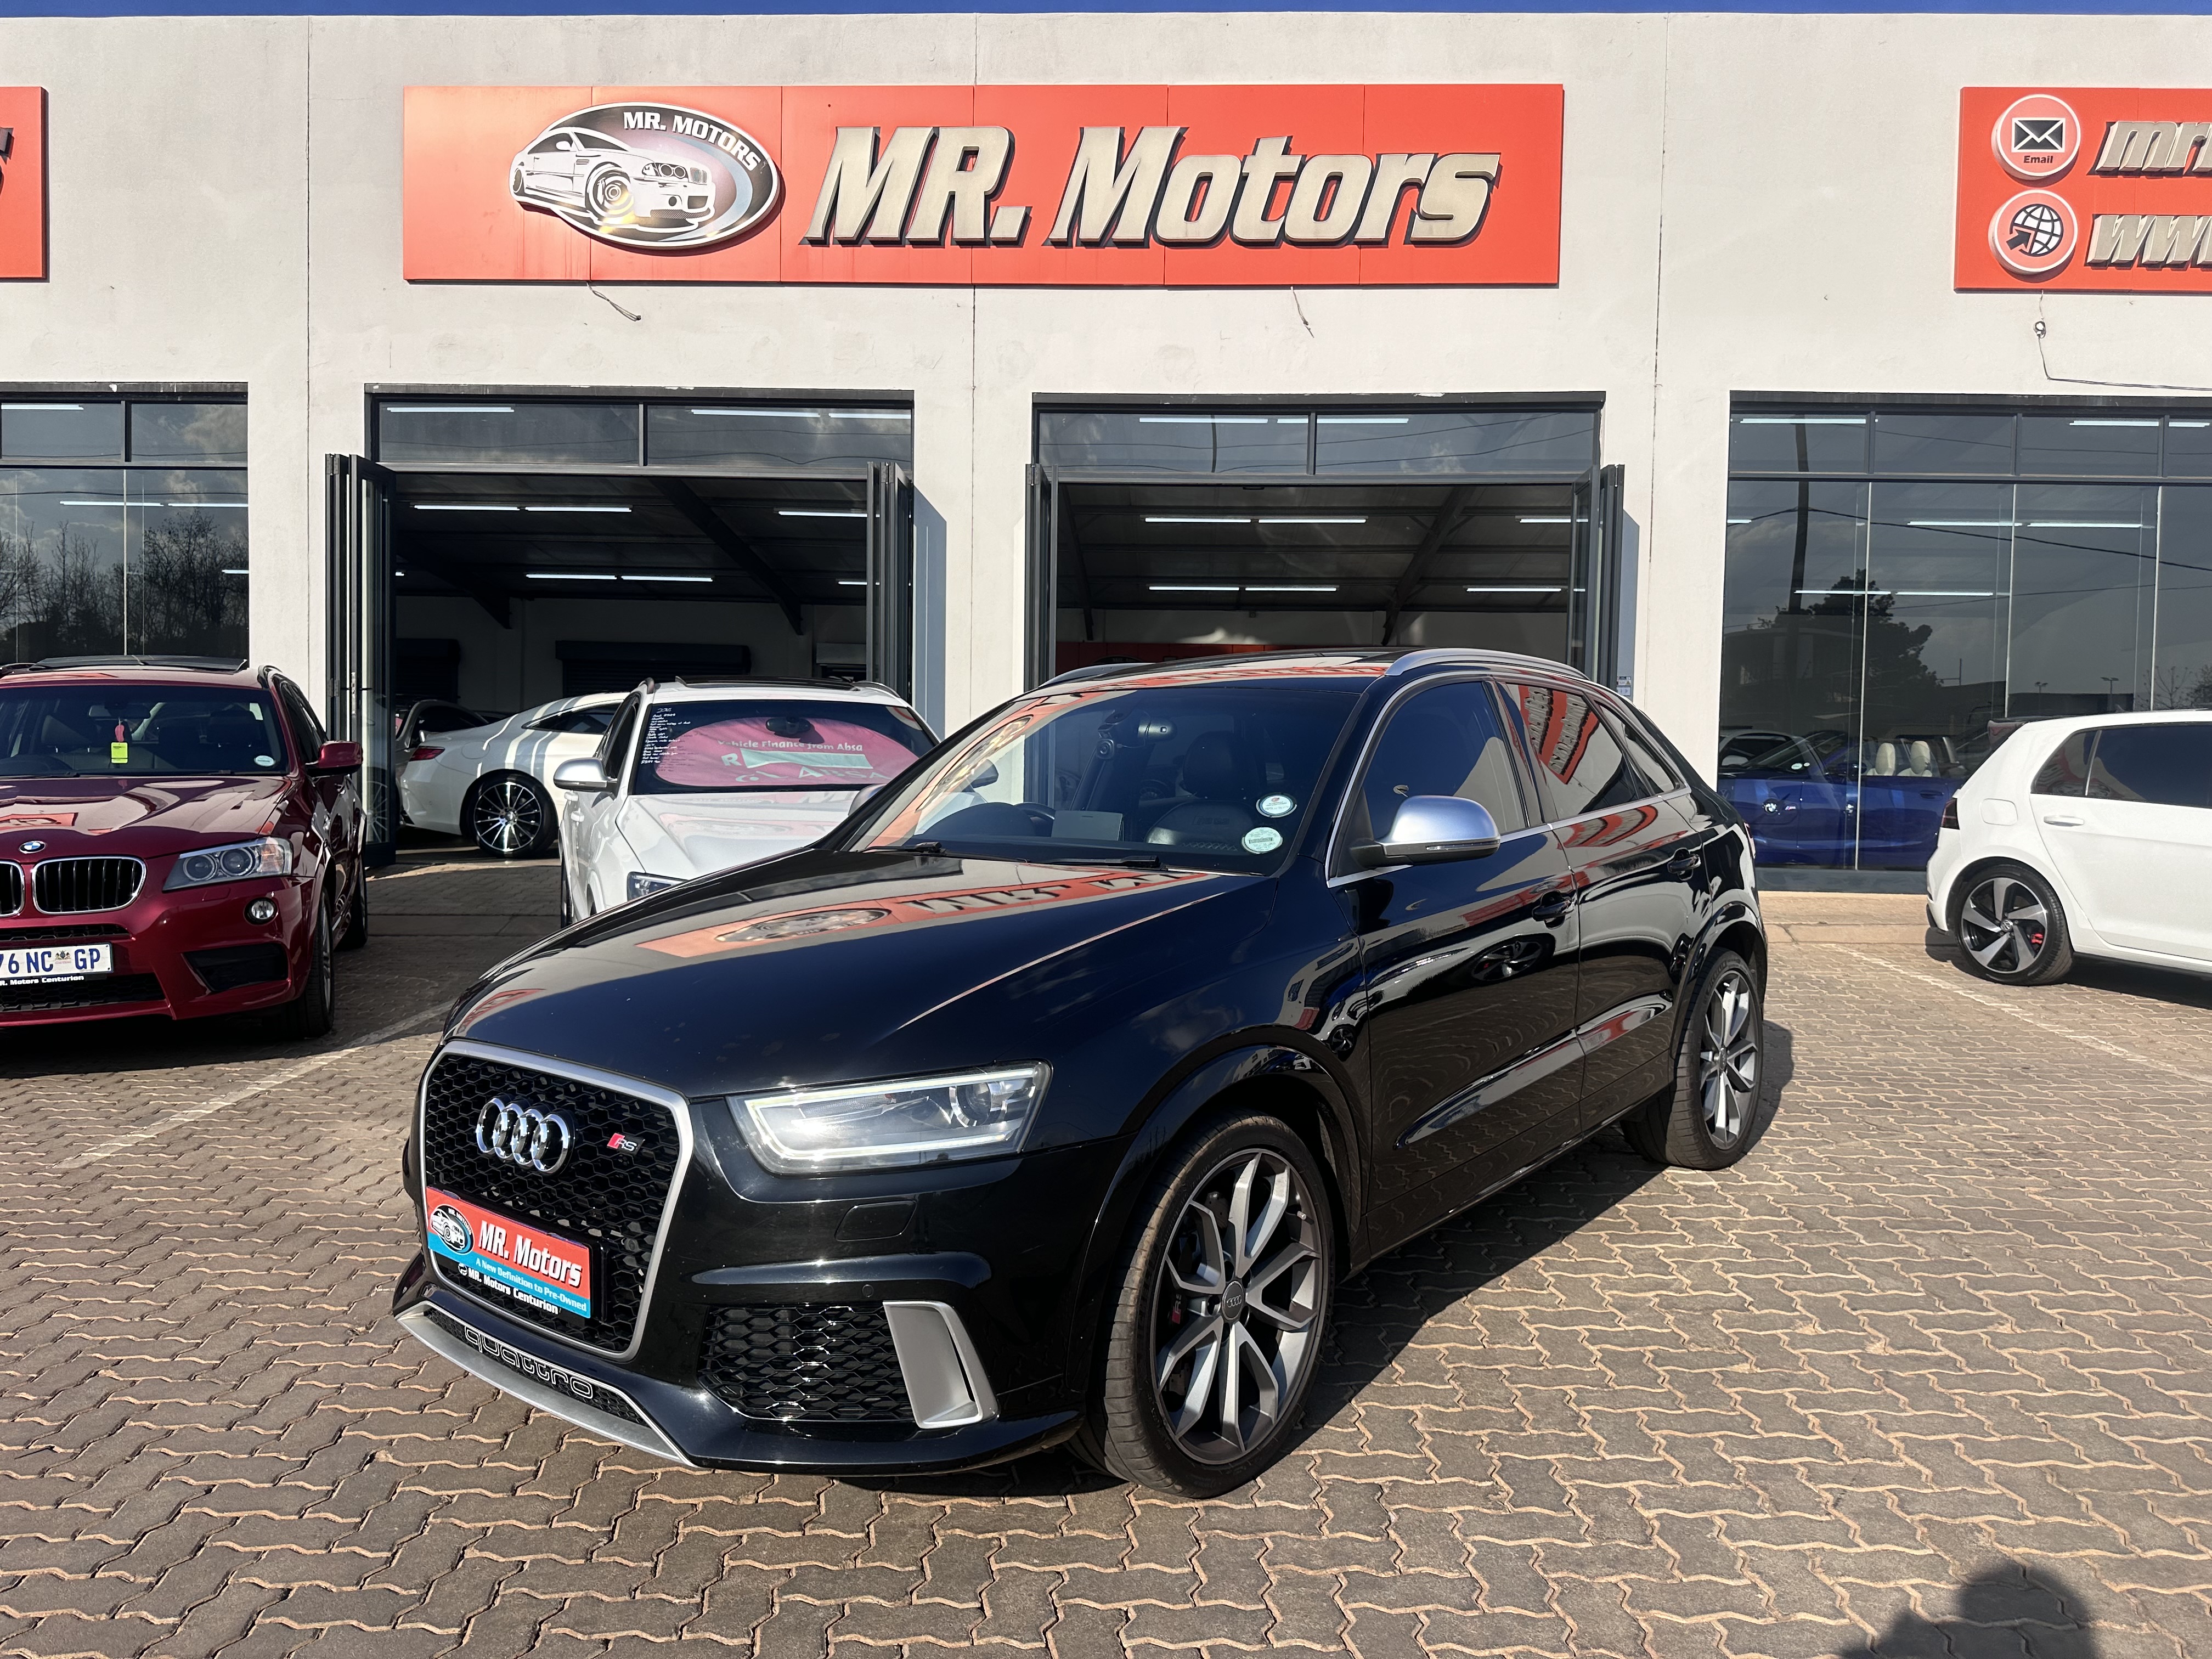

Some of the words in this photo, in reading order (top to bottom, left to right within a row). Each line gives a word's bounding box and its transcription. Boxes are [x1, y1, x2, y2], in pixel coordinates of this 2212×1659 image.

[623, 111, 667, 131] MR.
[672, 115, 761, 171] MOTORS
[2023, 155, 2053, 164] Email
[805, 127, 1031, 245] MR.
[1051, 127, 1501, 245] Motors
[2087, 215, 2212, 264] ww
[721, 753, 742, 766] R
[837, 742, 863, 752] Absa
[26, 951, 54, 973] NC
[74, 948, 100, 970] GP
[41, 975, 84, 983] Centurion
[611, 1136, 637, 1151] RS
[478, 1220, 510, 1260] MR.
[514, 1235, 582, 1287] Motors
[468, 1267, 482, 1283] MR.
[483, 1274, 511, 1296] Motors
[513, 1287, 559, 1315] Centurion
[476, 1257, 482, 1267] A
[482, 1260, 496, 1274] New
[498, 1267, 533, 1290] Definition
[534, 1283, 543, 1294] to
[544, 1286, 587, 1312] Pre-Owned
[464, 1325, 594, 1399] quattro
